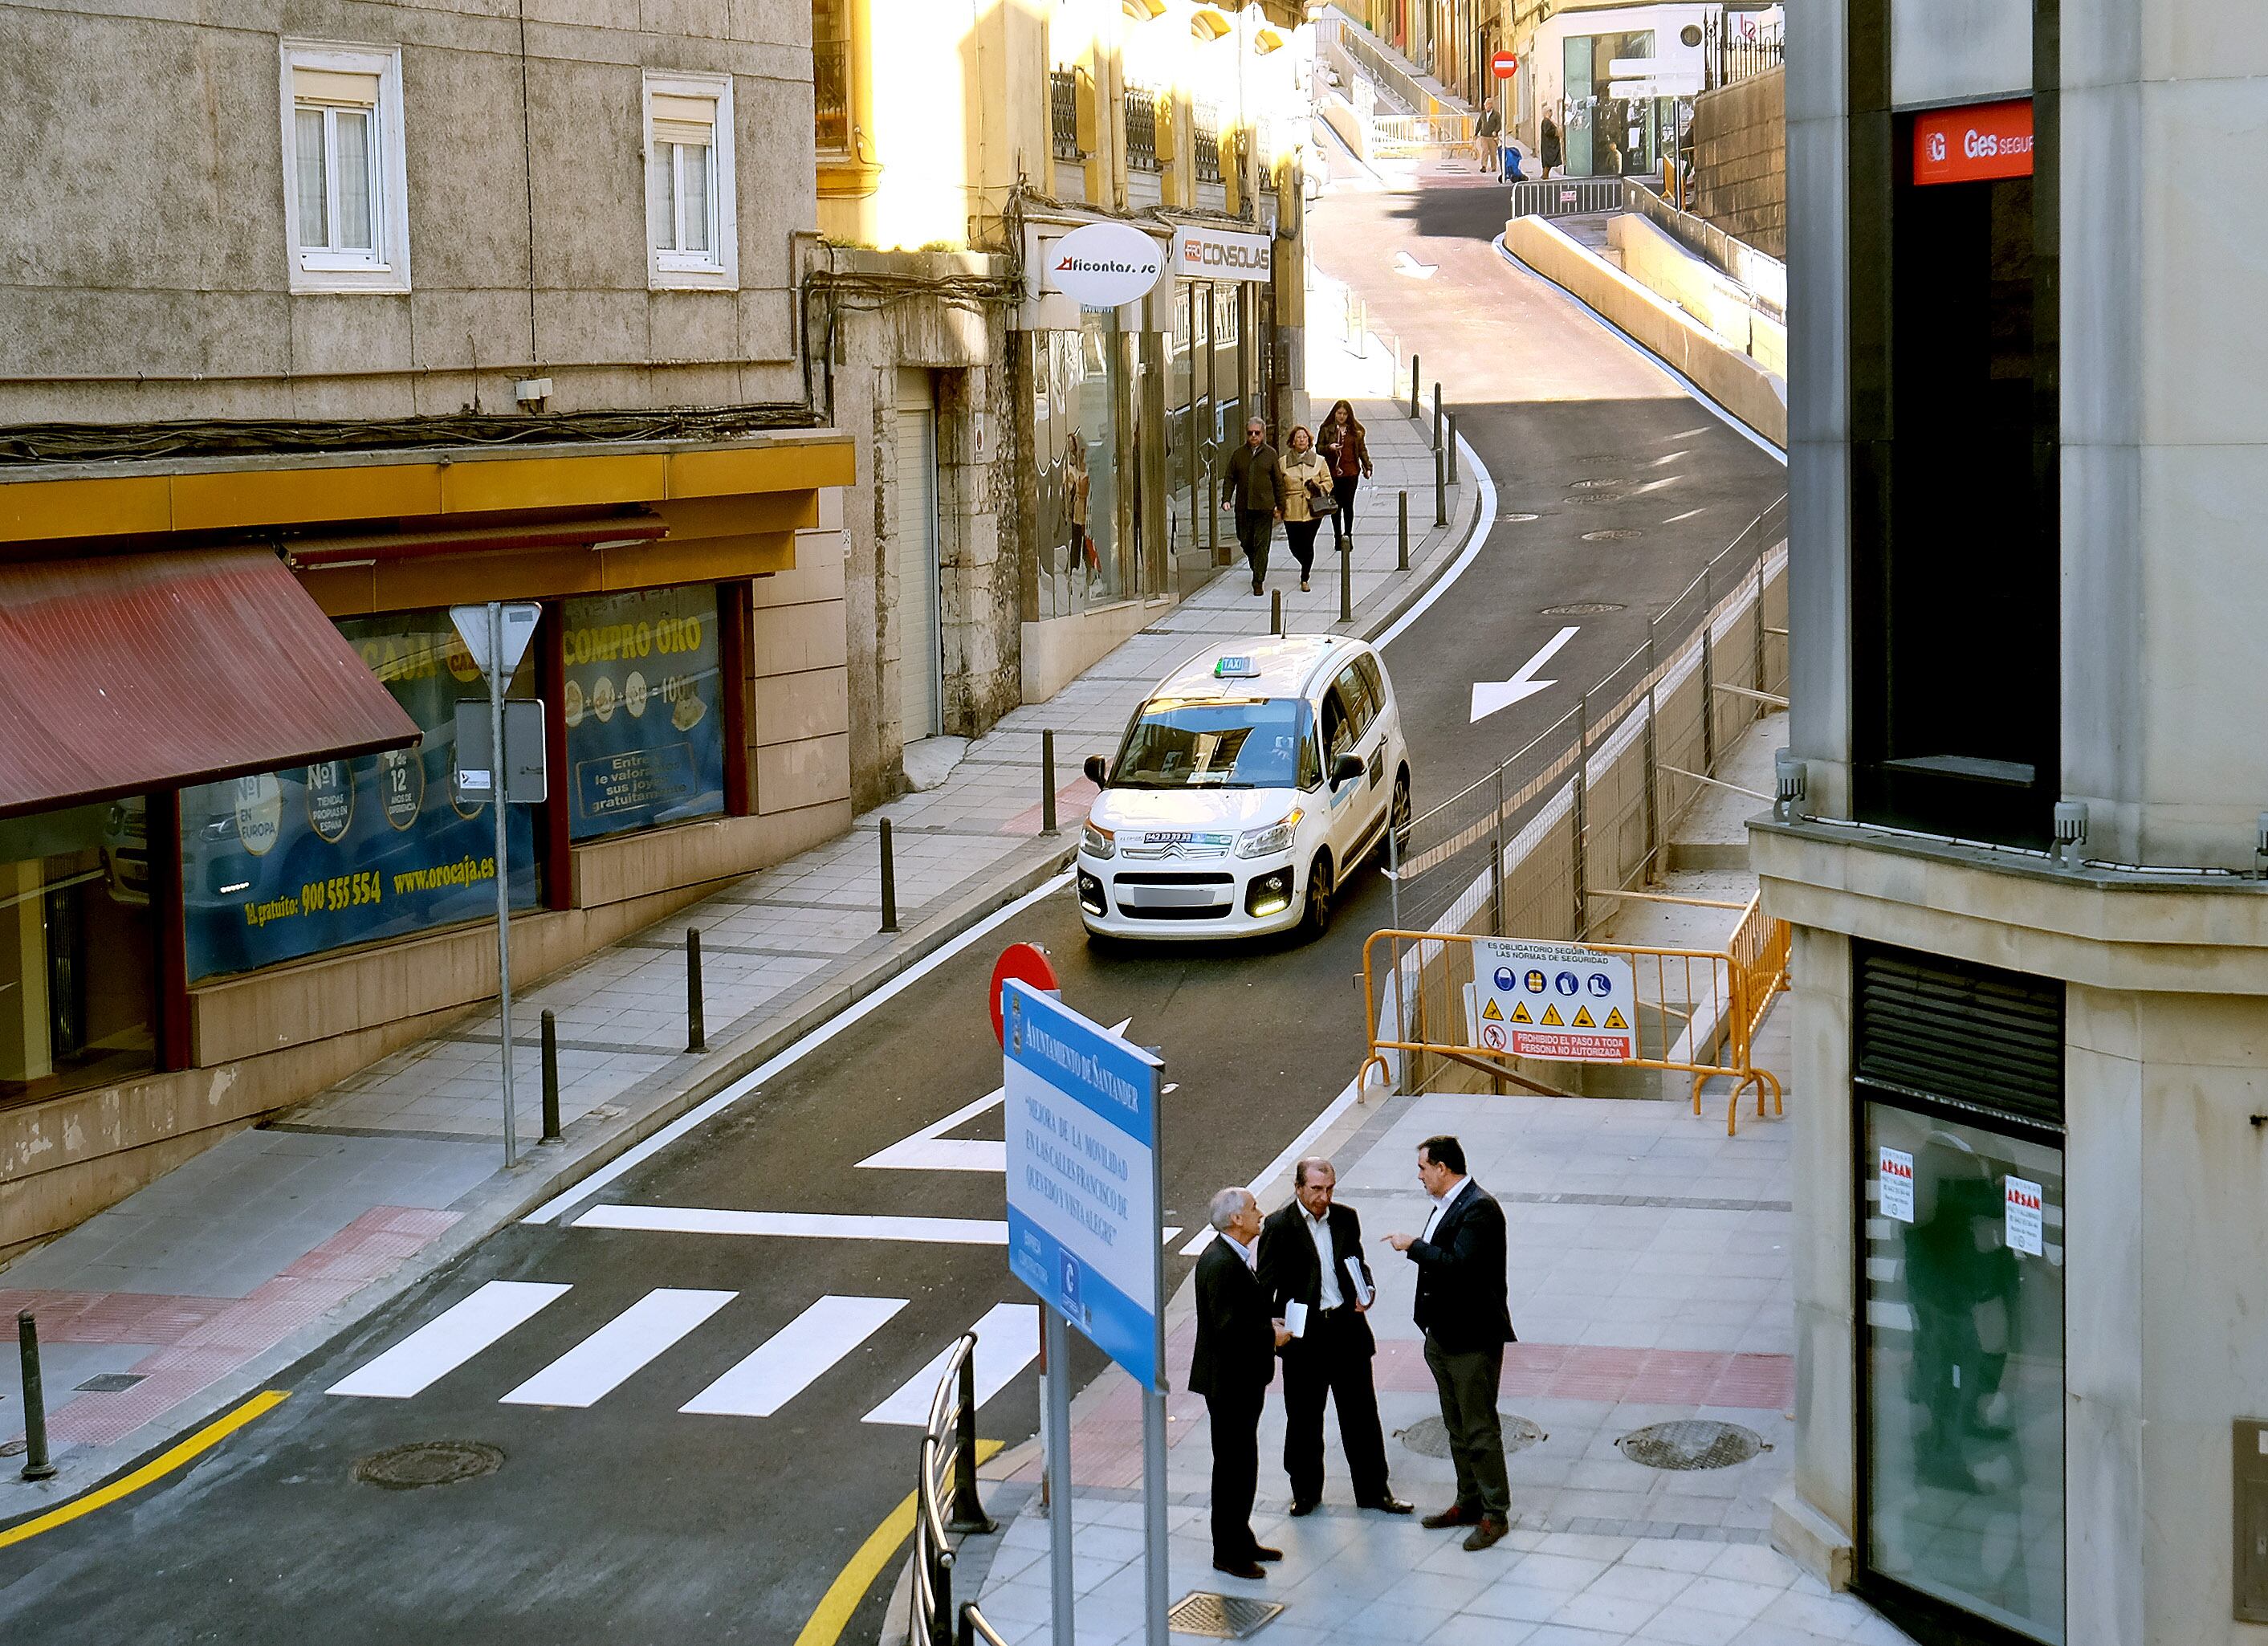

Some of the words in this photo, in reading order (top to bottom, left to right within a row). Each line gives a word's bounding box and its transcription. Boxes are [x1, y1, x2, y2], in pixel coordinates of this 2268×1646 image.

[1964, 129, 1997, 158] Ges
[1203, 242, 1269, 270] CONSOLAS
[1140, 264, 1157, 274] sc
[564, 621, 650, 666] COMPRO
[656, 616, 702, 654] ORO
[362, 637, 437, 681] CAJA
[1224, 658, 1241, 669] TAXI
[613, 756, 649, 770] Entre
[390, 768, 407, 792] 12
[595, 774, 608, 785] le
[606, 783, 629, 795] sus
[317, 794, 344, 807] TIENDAS
[591, 784, 687, 813] gratuitamente
[240, 808, 252, 822] EN
[313, 807, 340, 821] PROPIAS
[242, 821, 275, 840] EUROPA
[301, 882, 324, 916] 900
[328, 876, 349, 911] 555
[352, 871, 381, 905] 554
[393, 854, 495, 894] www.orocaja.es
[1499, 943, 1553, 954] OBLIGATORIO
[1555, 947, 1585, 955] SEGUIR
[1513, 951, 1547, 961] NORMAS
[1562, 955, 1609, 964] SEGURIDAD
[1517, 1033, 1558, 1044] PROHIBIDO
[1560, 1036, 1570, 1045] EL
[1571, 1037, 1593, 1046] PASO
[1594, 1038, 1601, 1046] A
[1601, 1038, 1624, 1047] TODA
[1521, 1043, 1557, 1054] PERSONA
[1558, 1045, 1570, 1055] NO
[1570, 1047, 1622, 1057] AUTORIZADA
[1026, 1017, 1081, 1077] AYUNTAMIENTO
[1081, 1055, 1092, 1084] DE
[1092, 1054, 1138, 1113] SANTANDER
[1059, 1116, 1069, 1141] DE
[1073, 1125, 1082, 1151] LA
[1085, 1134, 1128, 1180] MOVILIDAD
[1026, 1129, 1035, 1150] EN
[1049, 1145, 1076, 1181] CALLES
[1076, 1164, 1117, 1211] FRANCISCO
[1117, 1193, 1129, 1220] DE
[1881, 1159, 1912, 1179] ARSAN
[2007, 1188, 2041, 1211] ARSAN
